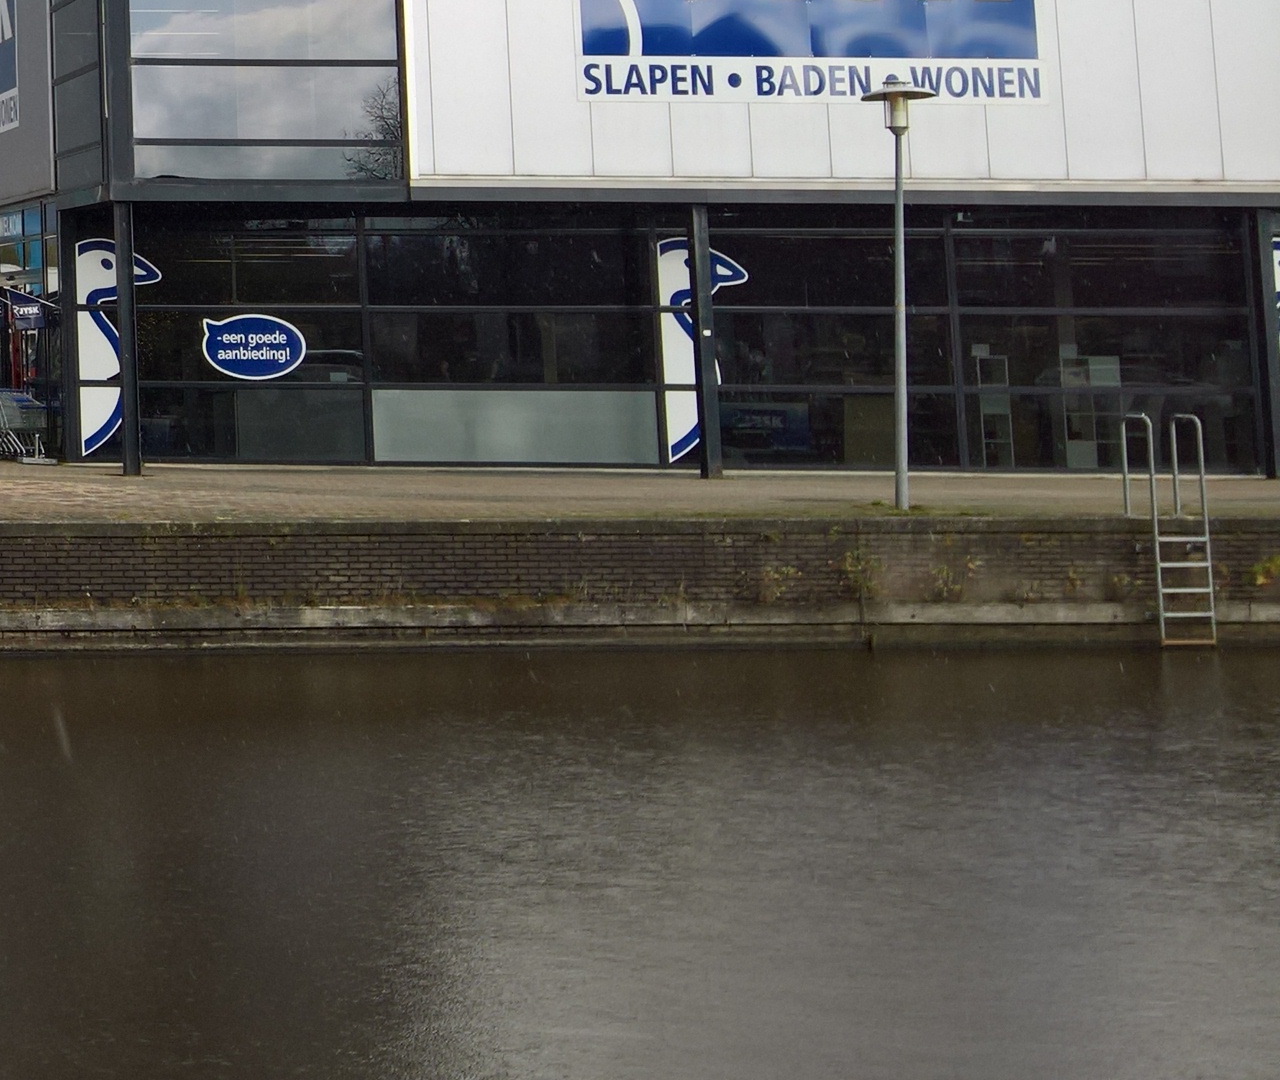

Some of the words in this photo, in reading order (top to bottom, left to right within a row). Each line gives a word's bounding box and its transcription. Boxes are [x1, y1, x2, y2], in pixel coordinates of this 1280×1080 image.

[583, 63, 715, 96] SLAPEN
[755, 64, 872, 98] BADEN
[910, 66, 1042, 99] WONEN
[19, 305, 39, 315] JYSK
[248, 330, 287, 347] goede
[217, 347, 291, 363] aanbieding!
